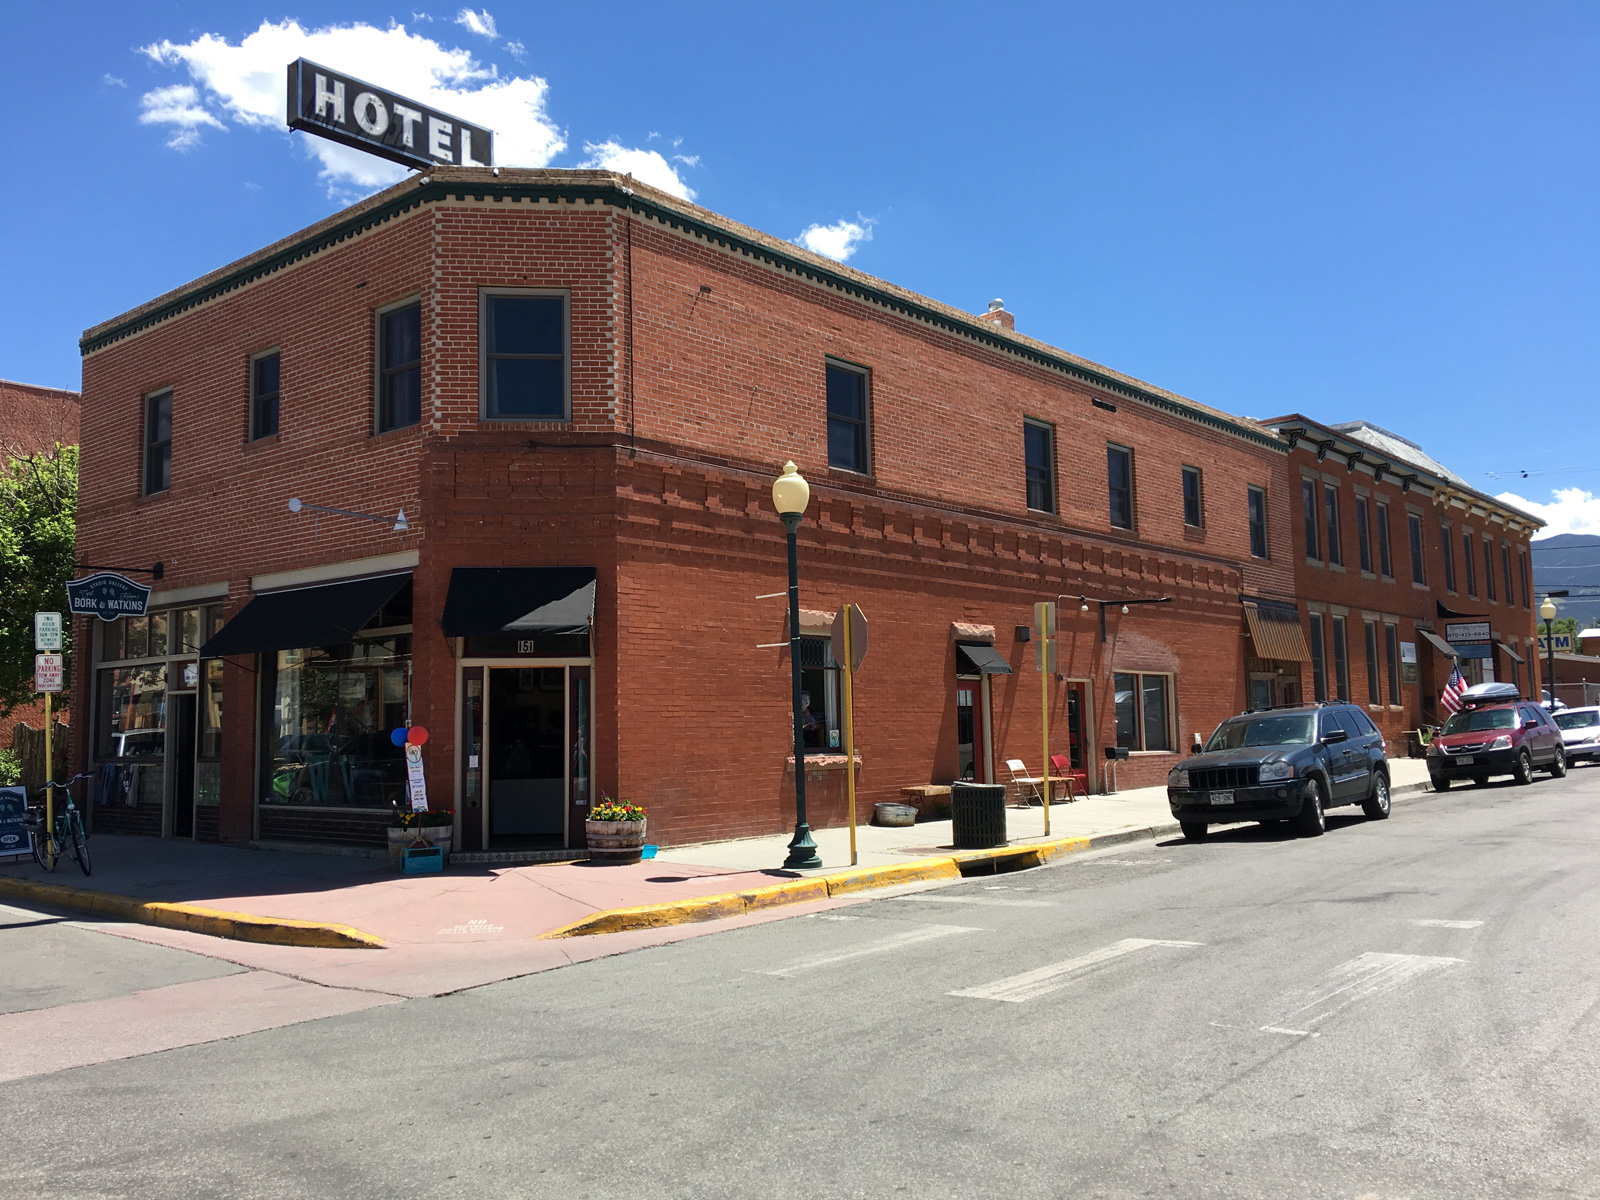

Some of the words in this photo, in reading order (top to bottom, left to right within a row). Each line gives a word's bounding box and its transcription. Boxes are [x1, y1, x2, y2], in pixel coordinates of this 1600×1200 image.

[315, 73, 484, 166] HOTEL
[90, 580, 106, 589] STUDIO
[108, 580, 128, 591] GALLERY
[74, 597, 97, 608] BORK
[99, 601, 106, 609] &
[107, 600, 143, 611] WATKINS
[519, 641, 533, 652] 151
